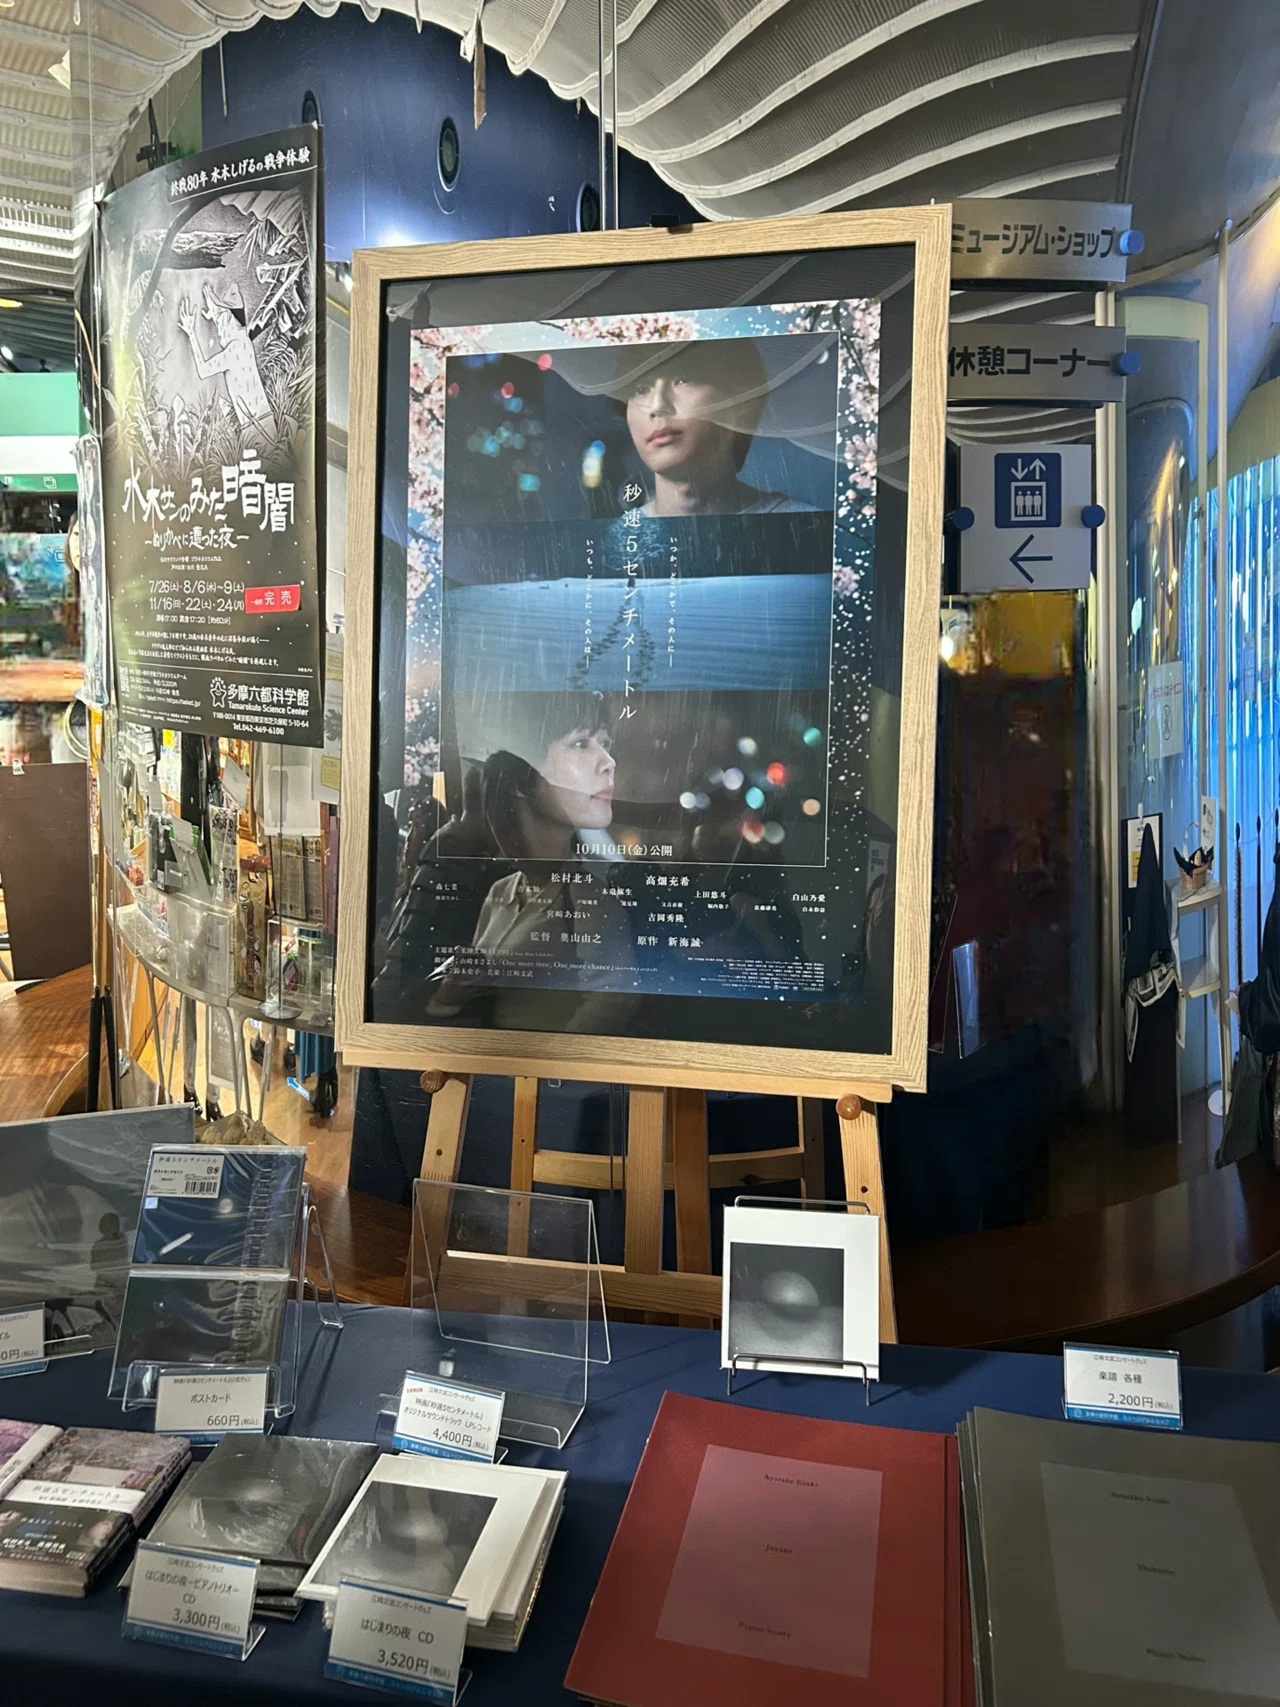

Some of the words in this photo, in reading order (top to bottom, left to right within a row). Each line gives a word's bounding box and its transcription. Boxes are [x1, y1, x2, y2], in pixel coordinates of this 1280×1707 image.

[211, 146, 311, 184] 水木しげるの戦争体験
[949, 345, 1111, 377] 休憩コーナー
[122, 449, 295, 532] 水木サンのみた暗闇
[228, 683, 310, 707] 多摩六都科学館
[262, 704, 286, 714] Science
[287, 706, 309, 716] Center
[551, 873, 594, 884] 松村北斗
[645, 875, 690, 886] 高畑充希
[648, 913, 684, 923] 吉岡秀隆
[530, 932, 551, 941] 監督
[560, 932, 602, 943] 奥山由之
[637, 936, 658, 946] 原作
[668, 936, 701, 948] 新海誠
[190, 1393, 232, 1404] ポストカード
[183, 1593, 196, 1605] CD
[361, 1618, 412, 1641] はじまりの夜
[418, 1630, 434, 1644] CD
